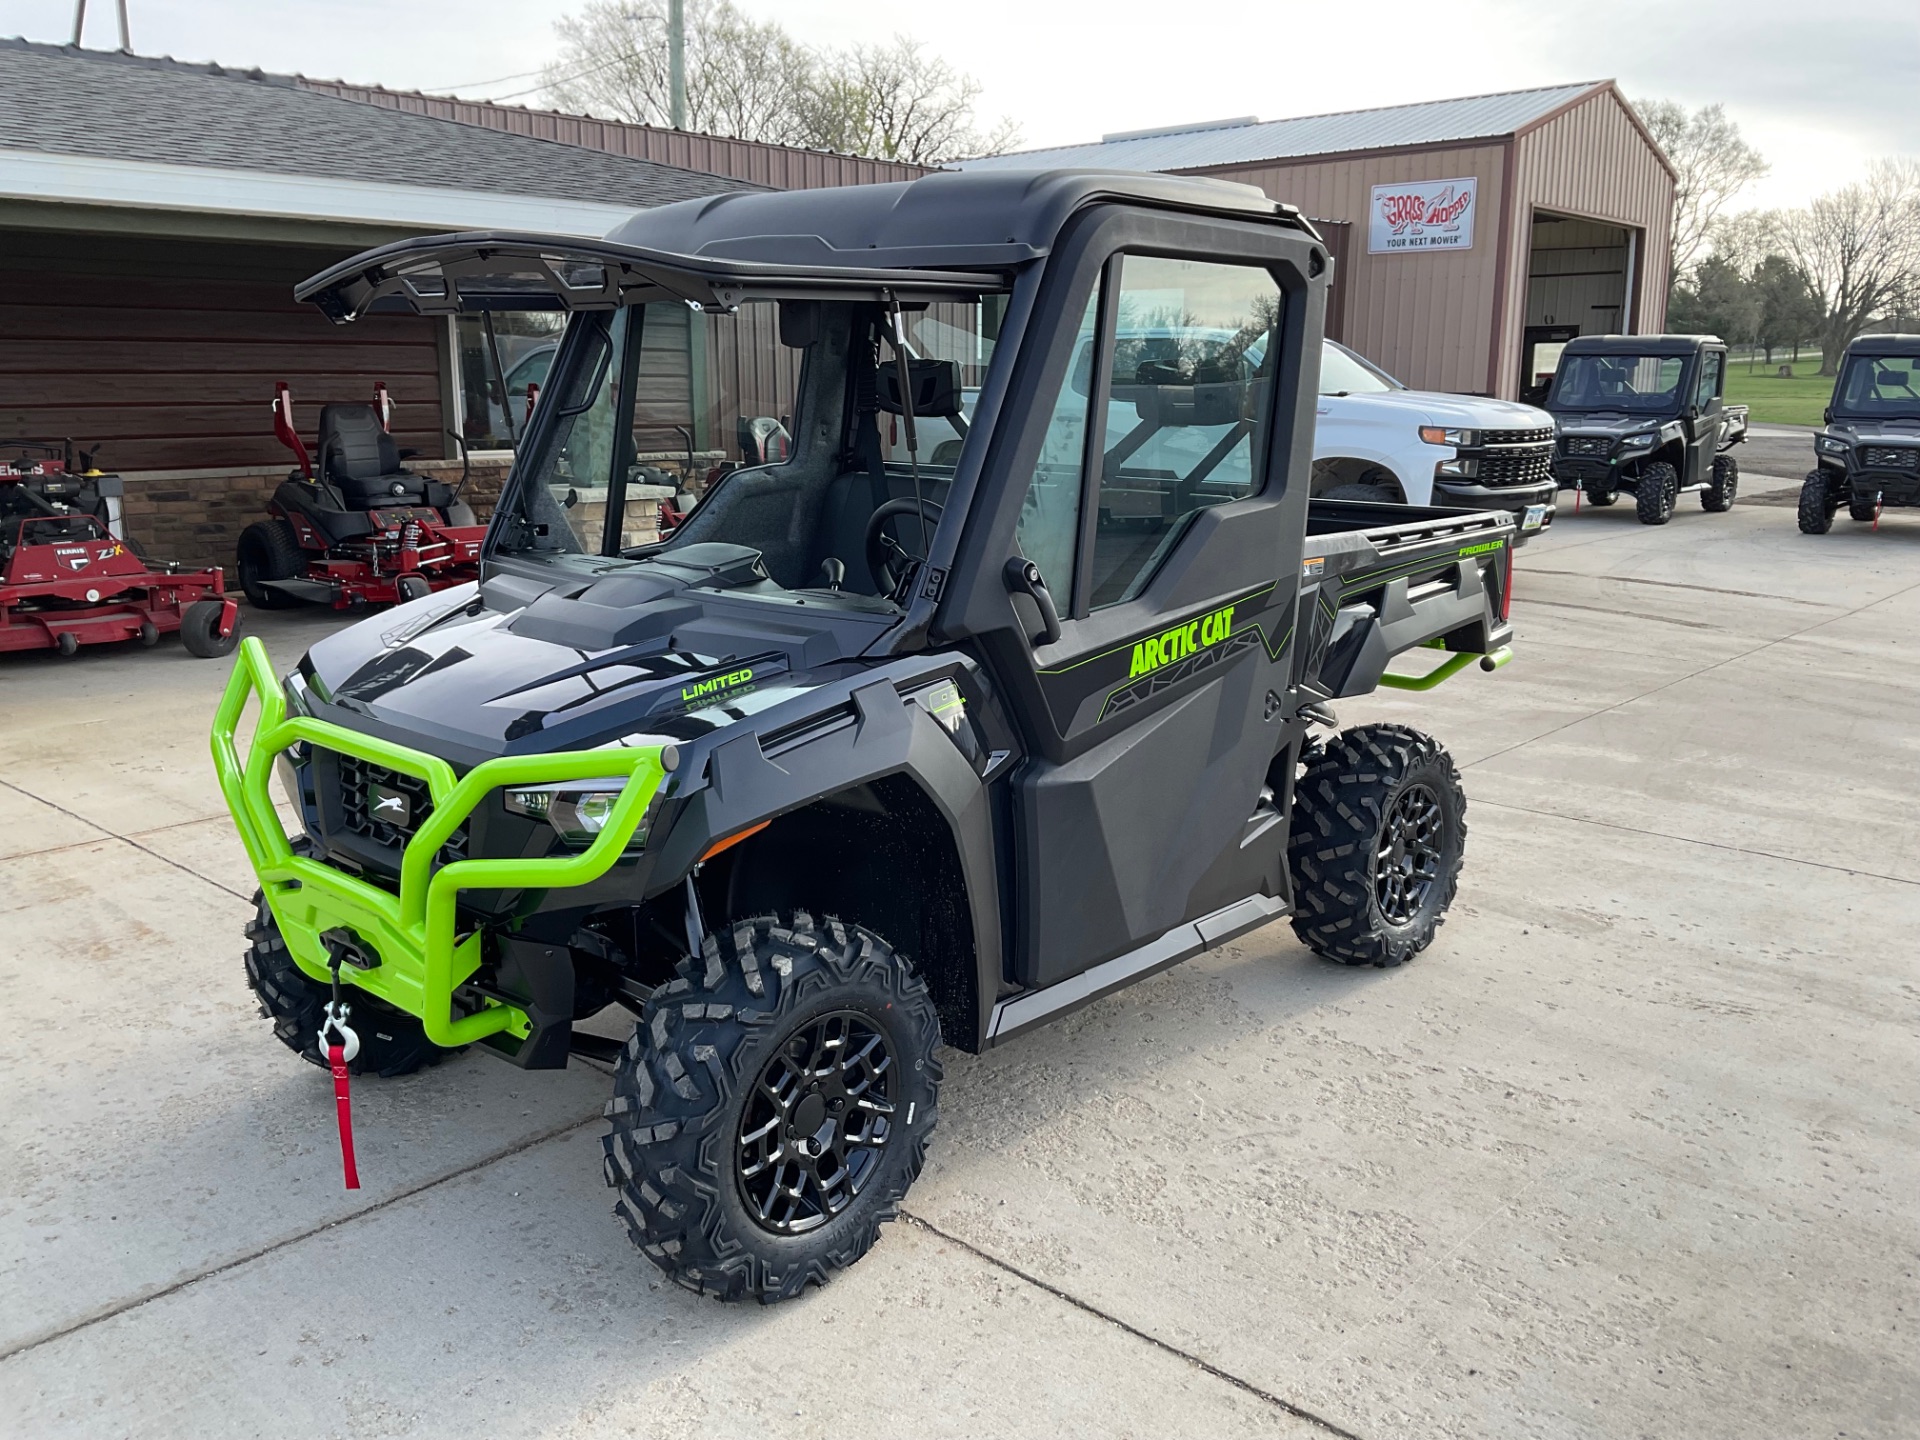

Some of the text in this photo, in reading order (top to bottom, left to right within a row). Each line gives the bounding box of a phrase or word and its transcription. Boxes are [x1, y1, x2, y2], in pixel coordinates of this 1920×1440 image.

[1386, 239, 1407, 248] YOUR
[1408, 237, 1428, 247] NEXT
[56, 547, 85, 555] FERRIS
[1459, 540, 1504, 557] PROWLER
[1129, 606, 1235, 679] ARCTIC CAT
[682, 668, 753, 701] LIMITED
